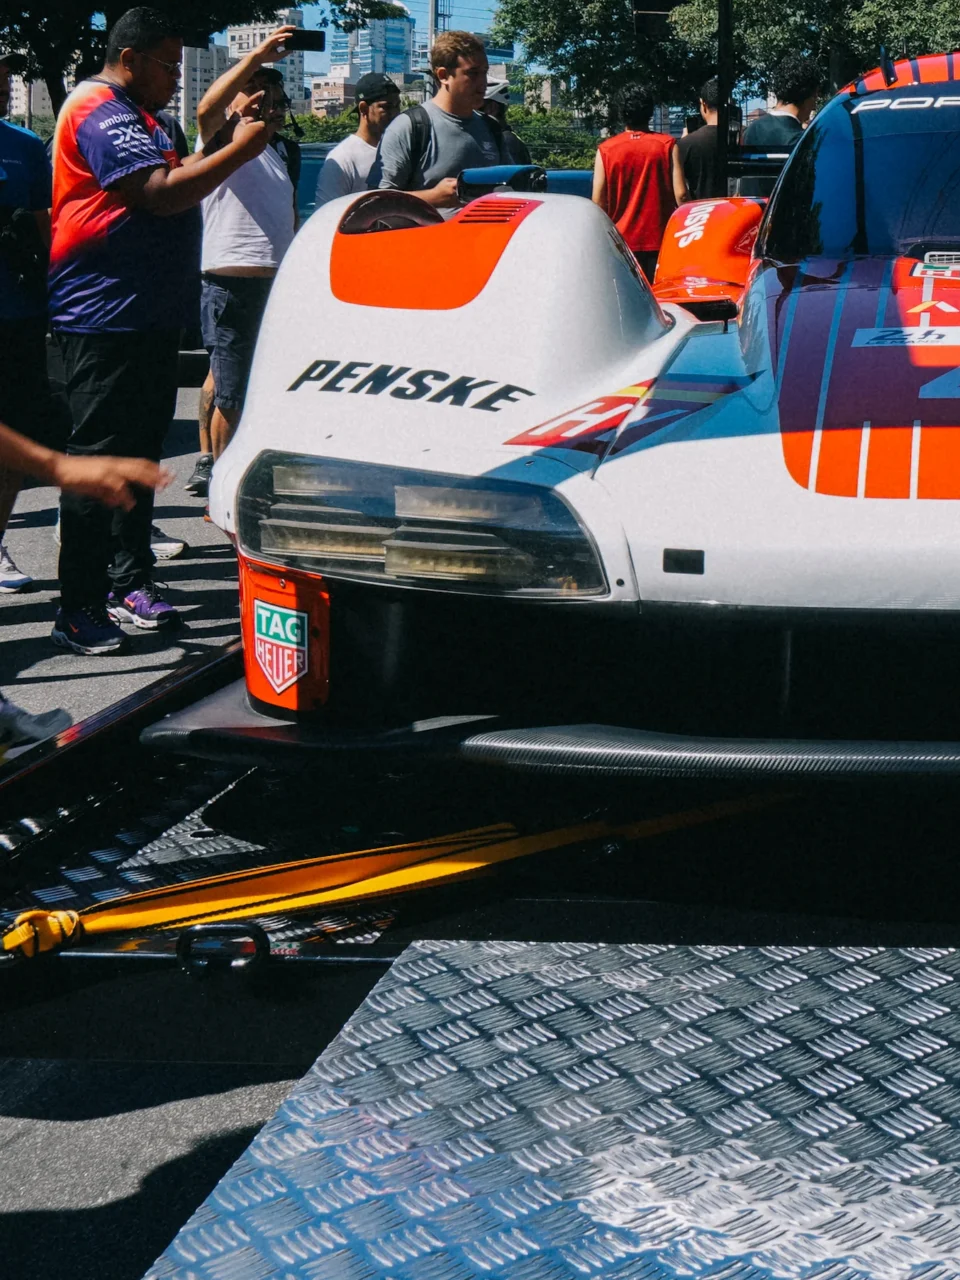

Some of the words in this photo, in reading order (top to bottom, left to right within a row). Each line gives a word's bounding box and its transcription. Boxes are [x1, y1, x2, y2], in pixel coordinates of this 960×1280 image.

[286, 359, 537, 412] PENSKE
[257, 607, 302, 643] TAG
[257, 638, 303, 685] HEUER
